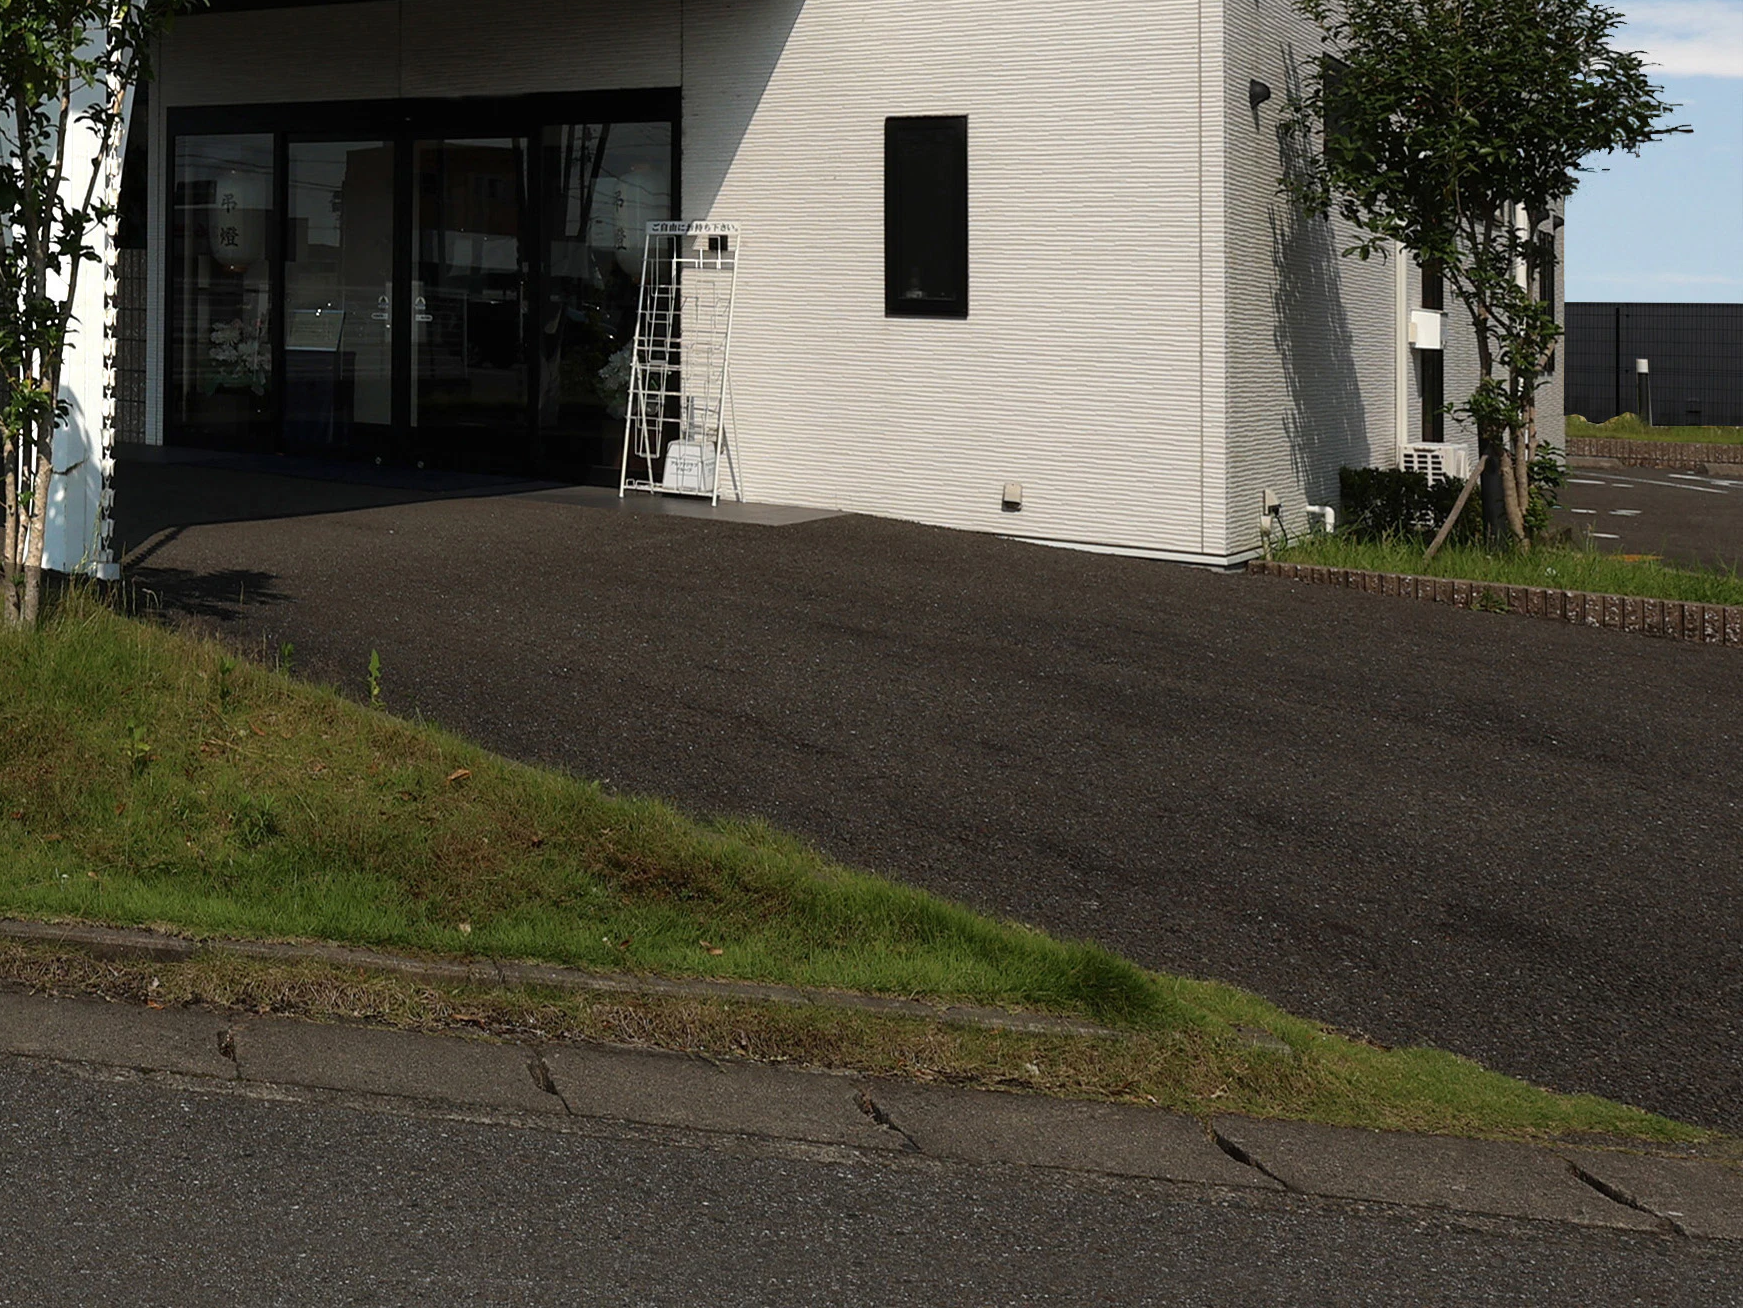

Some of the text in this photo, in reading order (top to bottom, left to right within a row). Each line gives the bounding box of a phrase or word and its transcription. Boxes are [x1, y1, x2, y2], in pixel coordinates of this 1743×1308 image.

[652, 223, 738, 232] ご自由にお持ち下さい。
